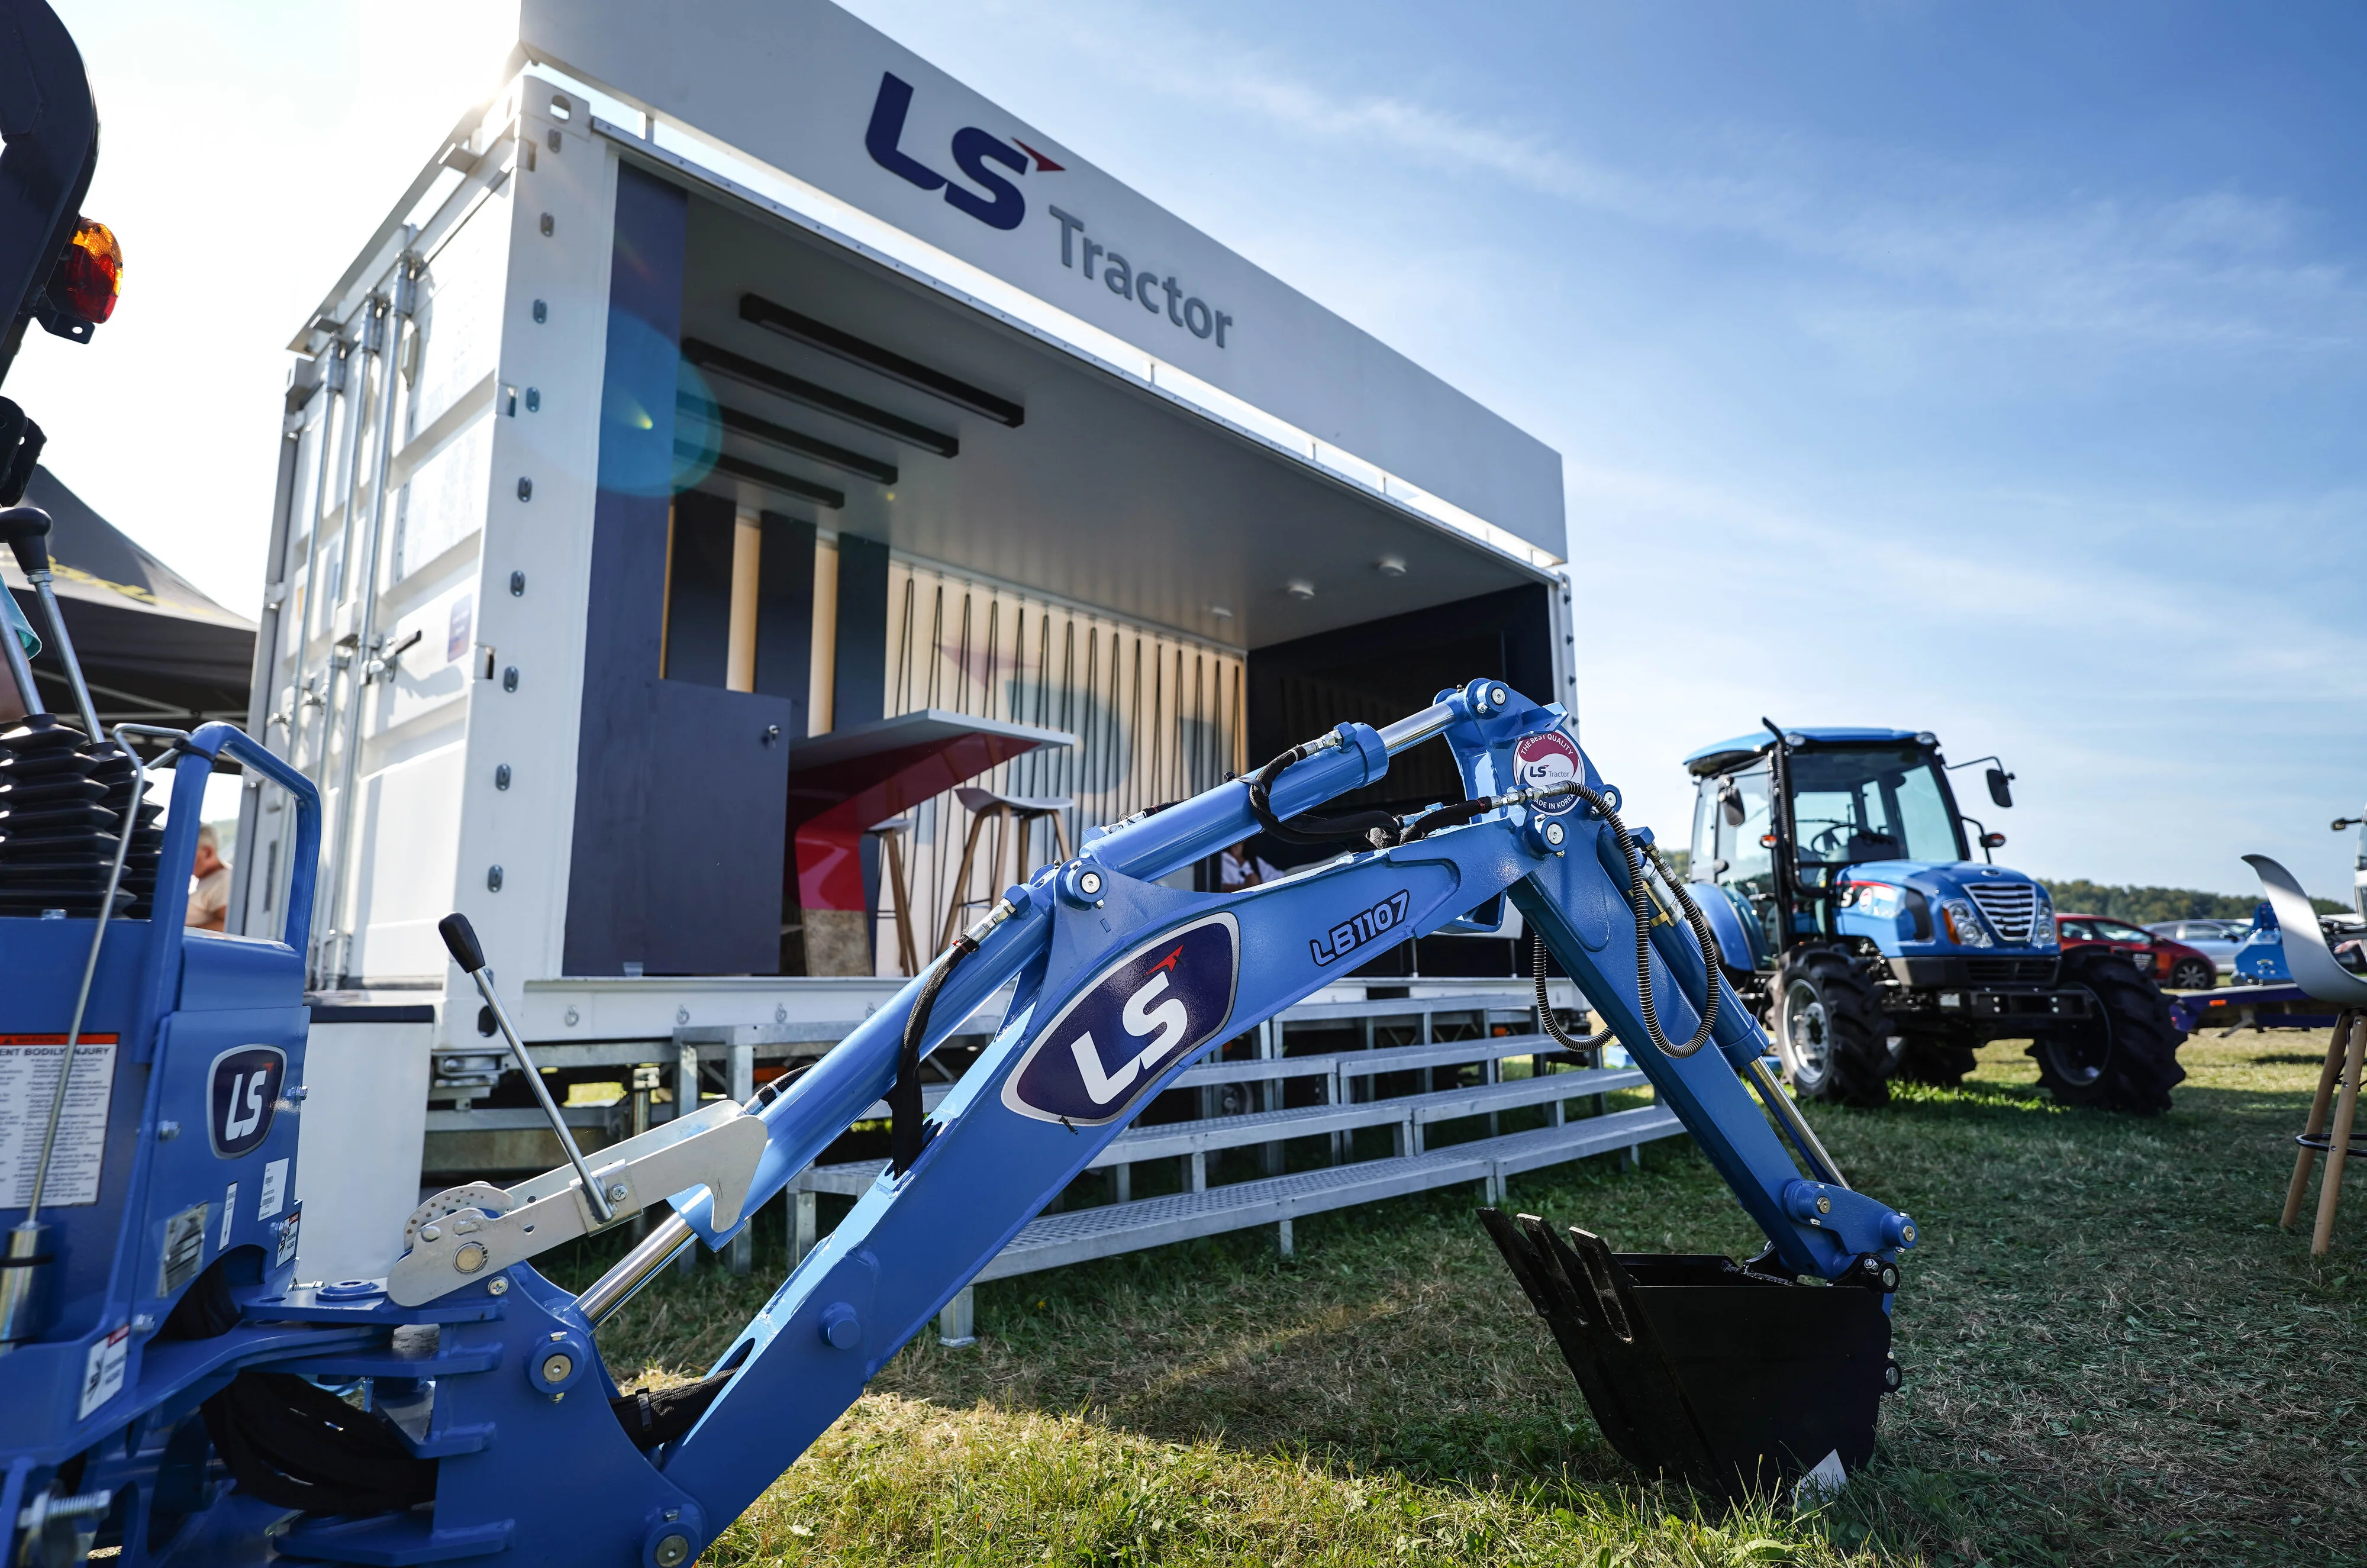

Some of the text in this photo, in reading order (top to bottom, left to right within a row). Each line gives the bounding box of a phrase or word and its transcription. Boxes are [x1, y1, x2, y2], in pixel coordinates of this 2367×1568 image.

[865, 70, 1029, 231] LS
[1049, 204, 1233, 348] Tractor
[1520, 733, 1574, 755] THE BEST QUALITY
[1530, 766, 1546, 777] LS
[1533, 798, 1547, 808] ADE
[1556, 793, 1575, 809] KOREA
[1310, 889, 1410, 967] LB1107
[24, 1047, 67, 1056] BODILY
[1070, 970, 1188, 1105] LS
[225, 1070, 267, 1141] LS
